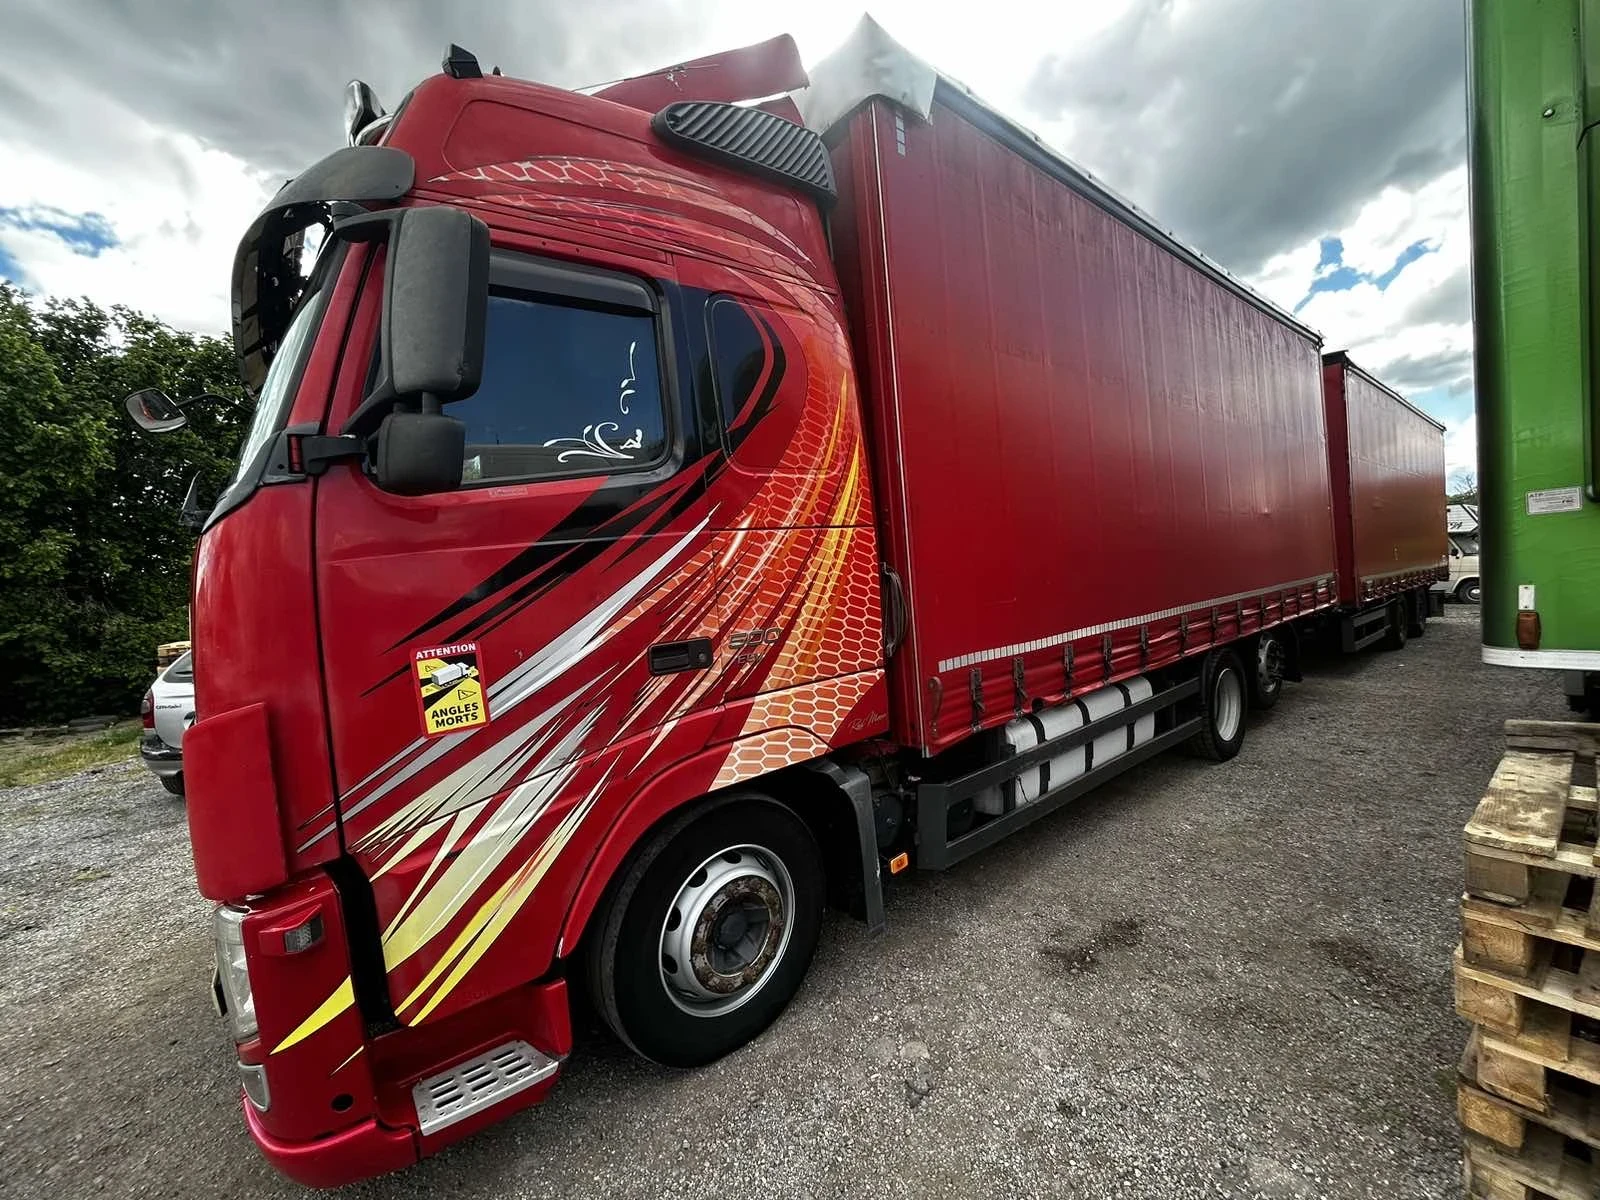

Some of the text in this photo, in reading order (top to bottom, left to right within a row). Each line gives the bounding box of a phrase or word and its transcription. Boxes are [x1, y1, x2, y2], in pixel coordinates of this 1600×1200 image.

[416, 643, 476, 659] ATTENTION
[431, 702, 479, 719] ANGLES
[435, 712, 478, 728] MORTS
